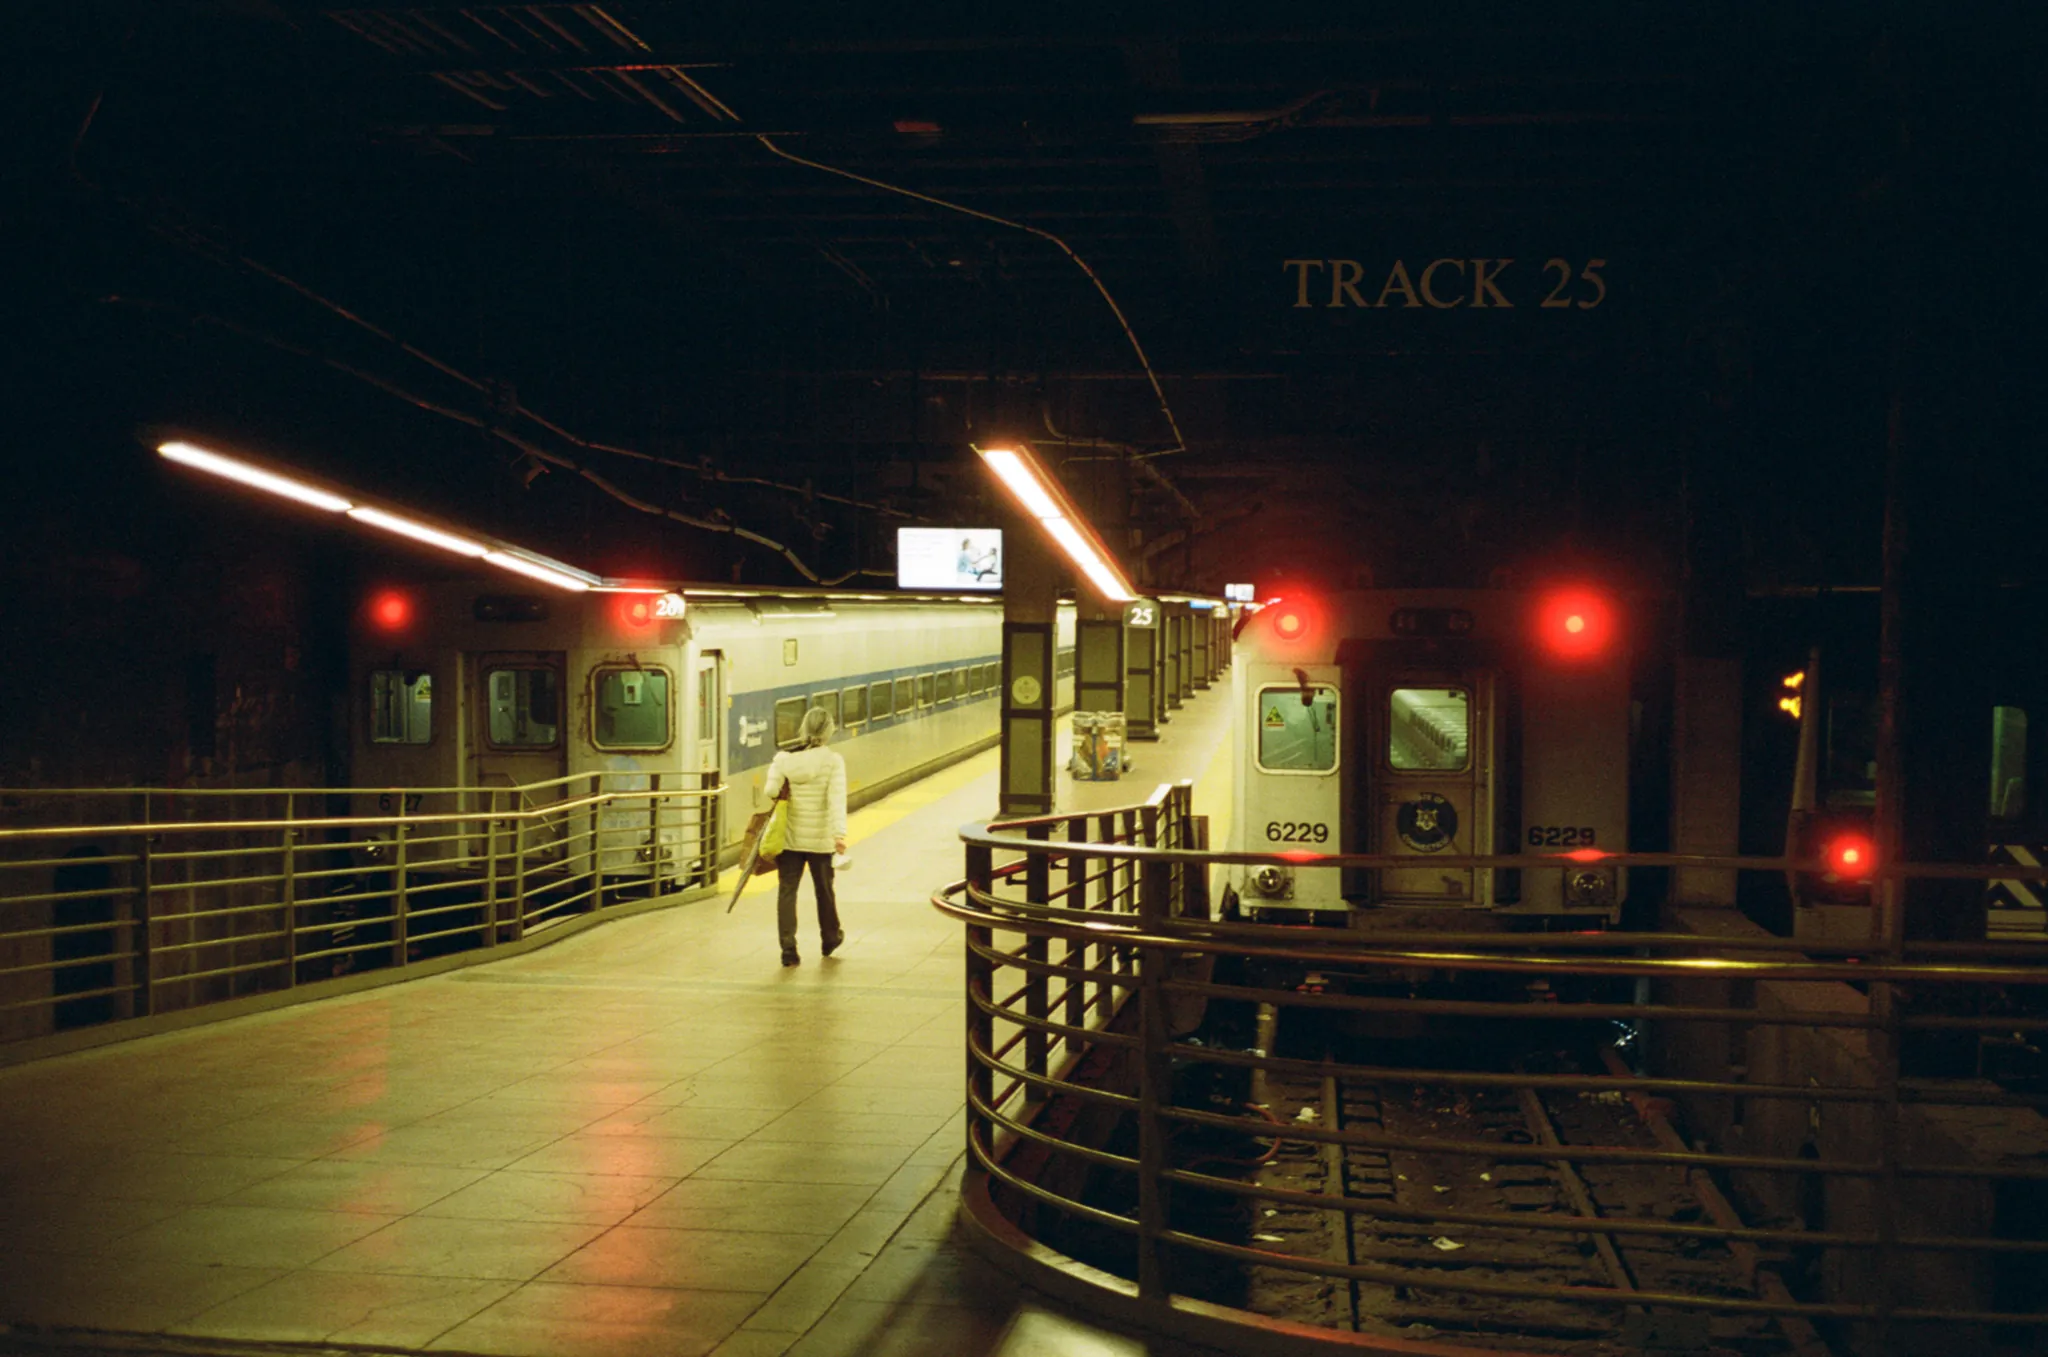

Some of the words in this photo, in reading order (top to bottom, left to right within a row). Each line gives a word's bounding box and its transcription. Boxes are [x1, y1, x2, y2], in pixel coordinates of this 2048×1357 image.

[1282, 257, 1515, 309] TRACK
[1539, 257, 1608, 310] 25
[1130, 607, 1153, 626] 25
[1266, 821, 1329, 843] 6229
[1527, 825, 1596, 847] 6229
